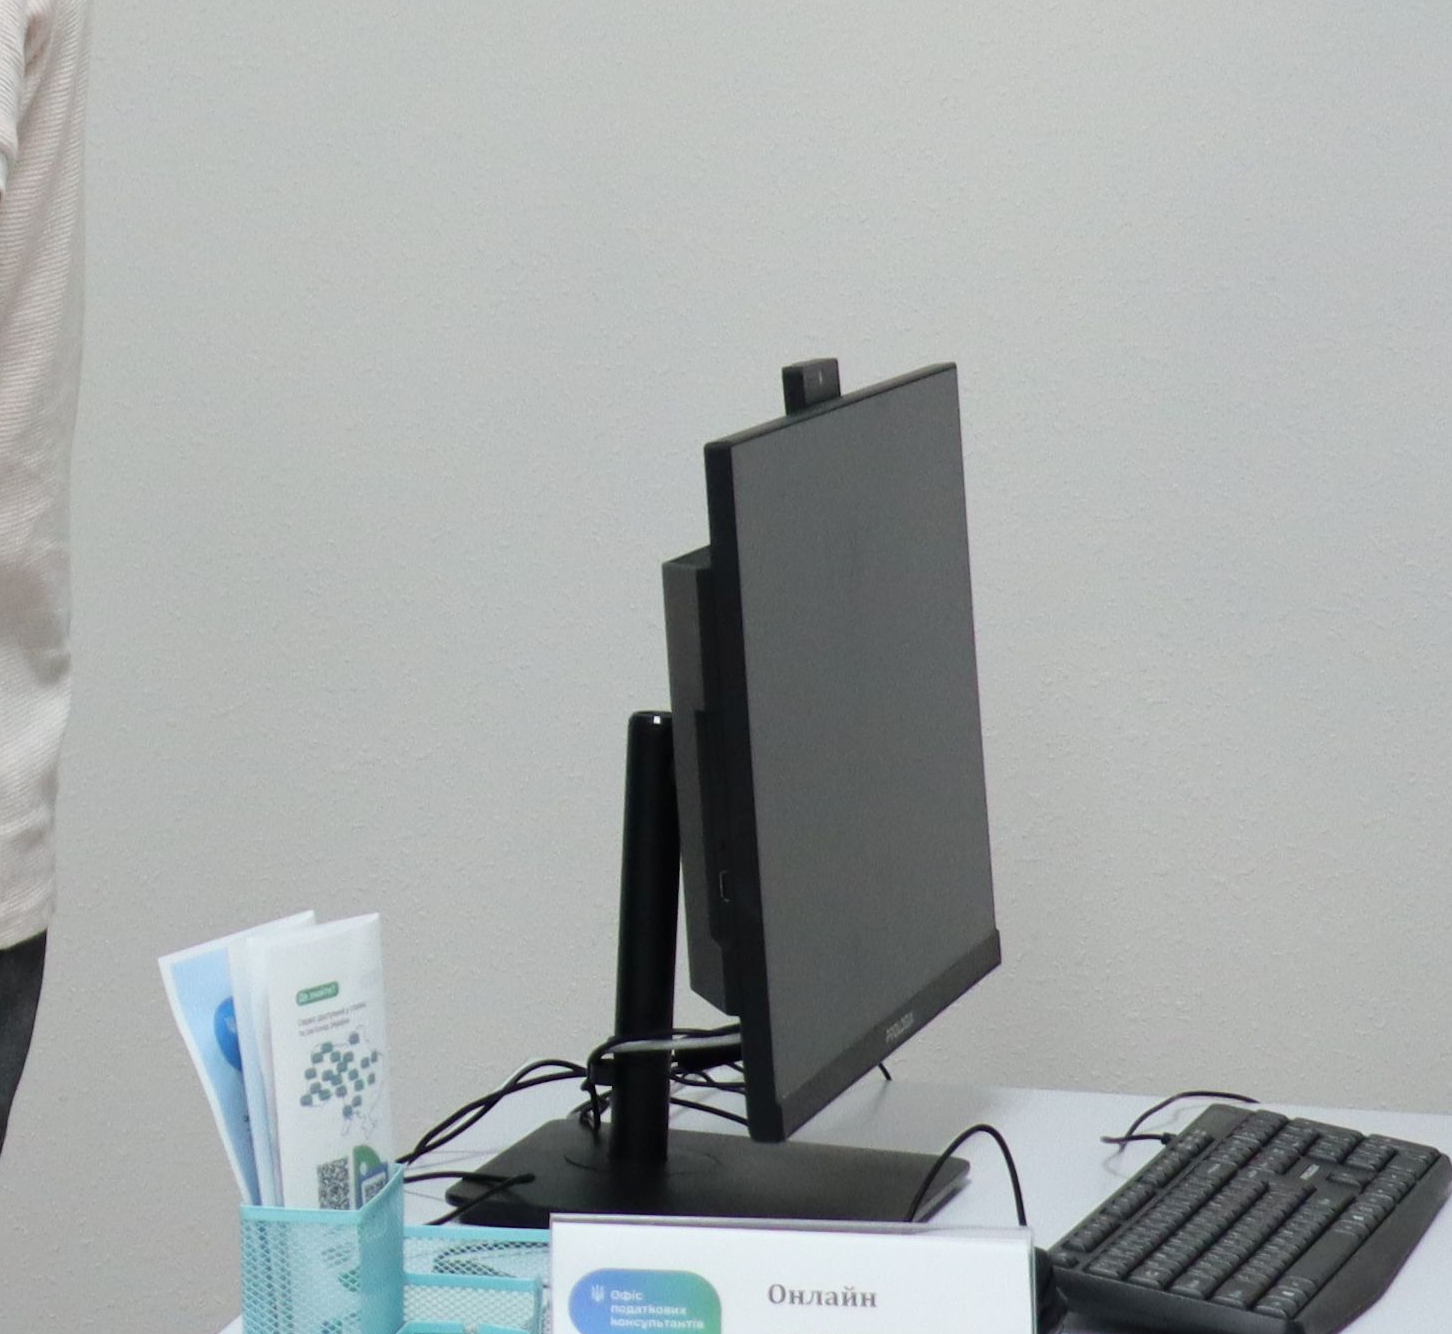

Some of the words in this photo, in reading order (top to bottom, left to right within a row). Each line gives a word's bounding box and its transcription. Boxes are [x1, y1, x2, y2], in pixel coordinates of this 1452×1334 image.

[610, 1290, 644, 1302] Офіс
[768, 1283, 877, 1308] Онлайн
[610, 1304, 687, 1315] податкових
[610, 1316, 704, 1329] консультантів
